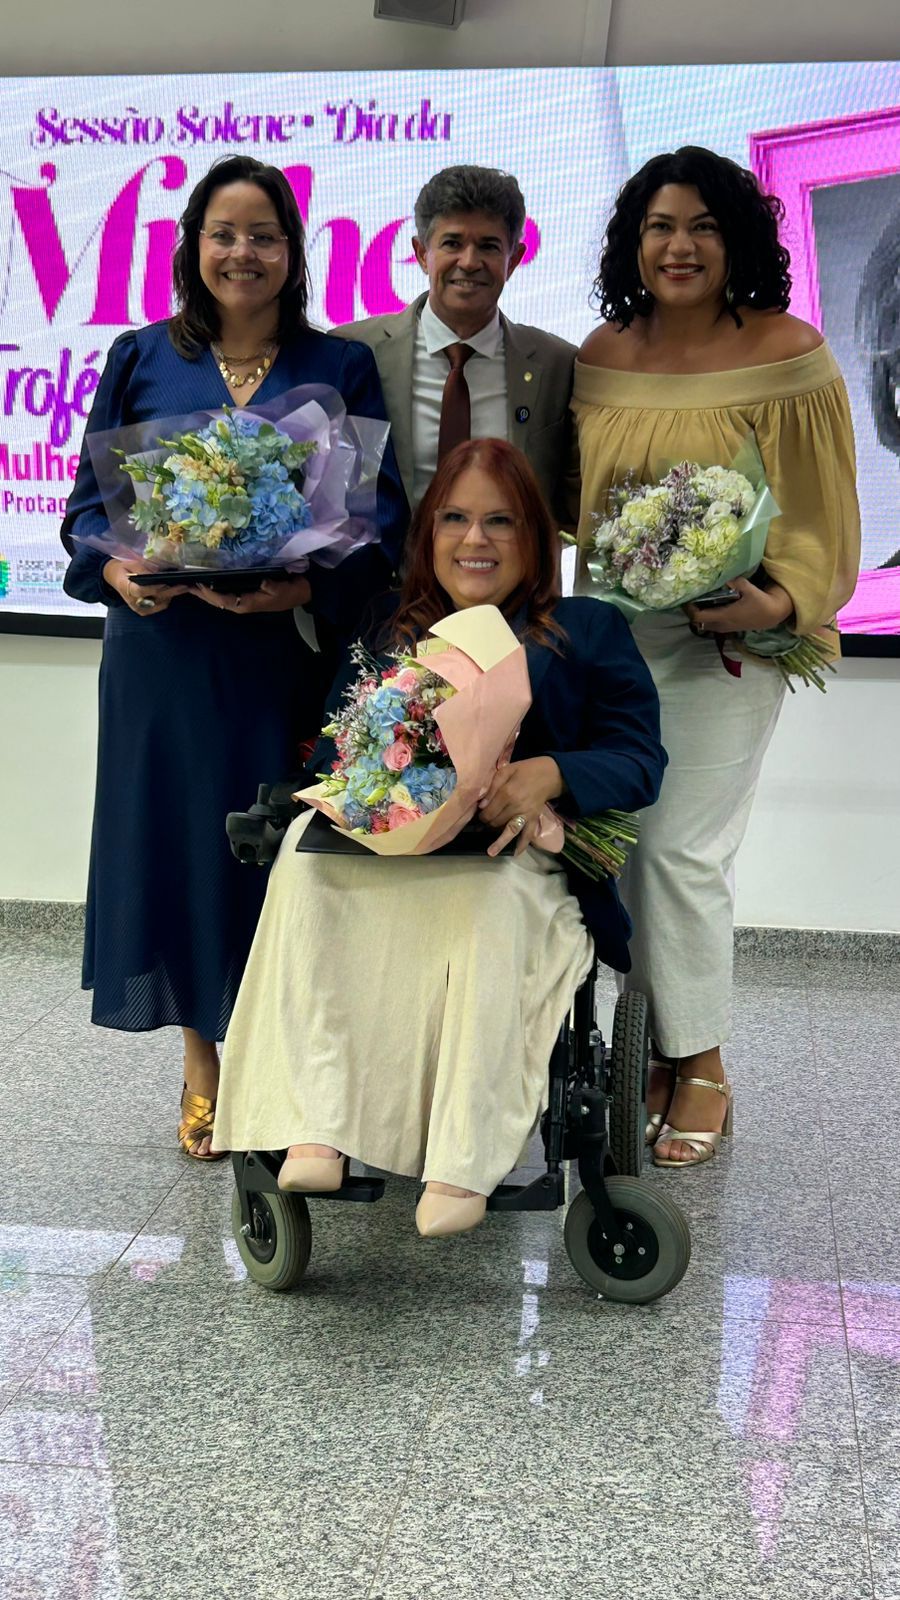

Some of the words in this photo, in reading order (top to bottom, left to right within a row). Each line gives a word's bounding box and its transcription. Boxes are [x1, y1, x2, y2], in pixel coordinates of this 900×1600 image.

[30, 105, 164, 148] Sessão
[170, 101, 294, 148] Solene
[405, 98, 453, 142] da
